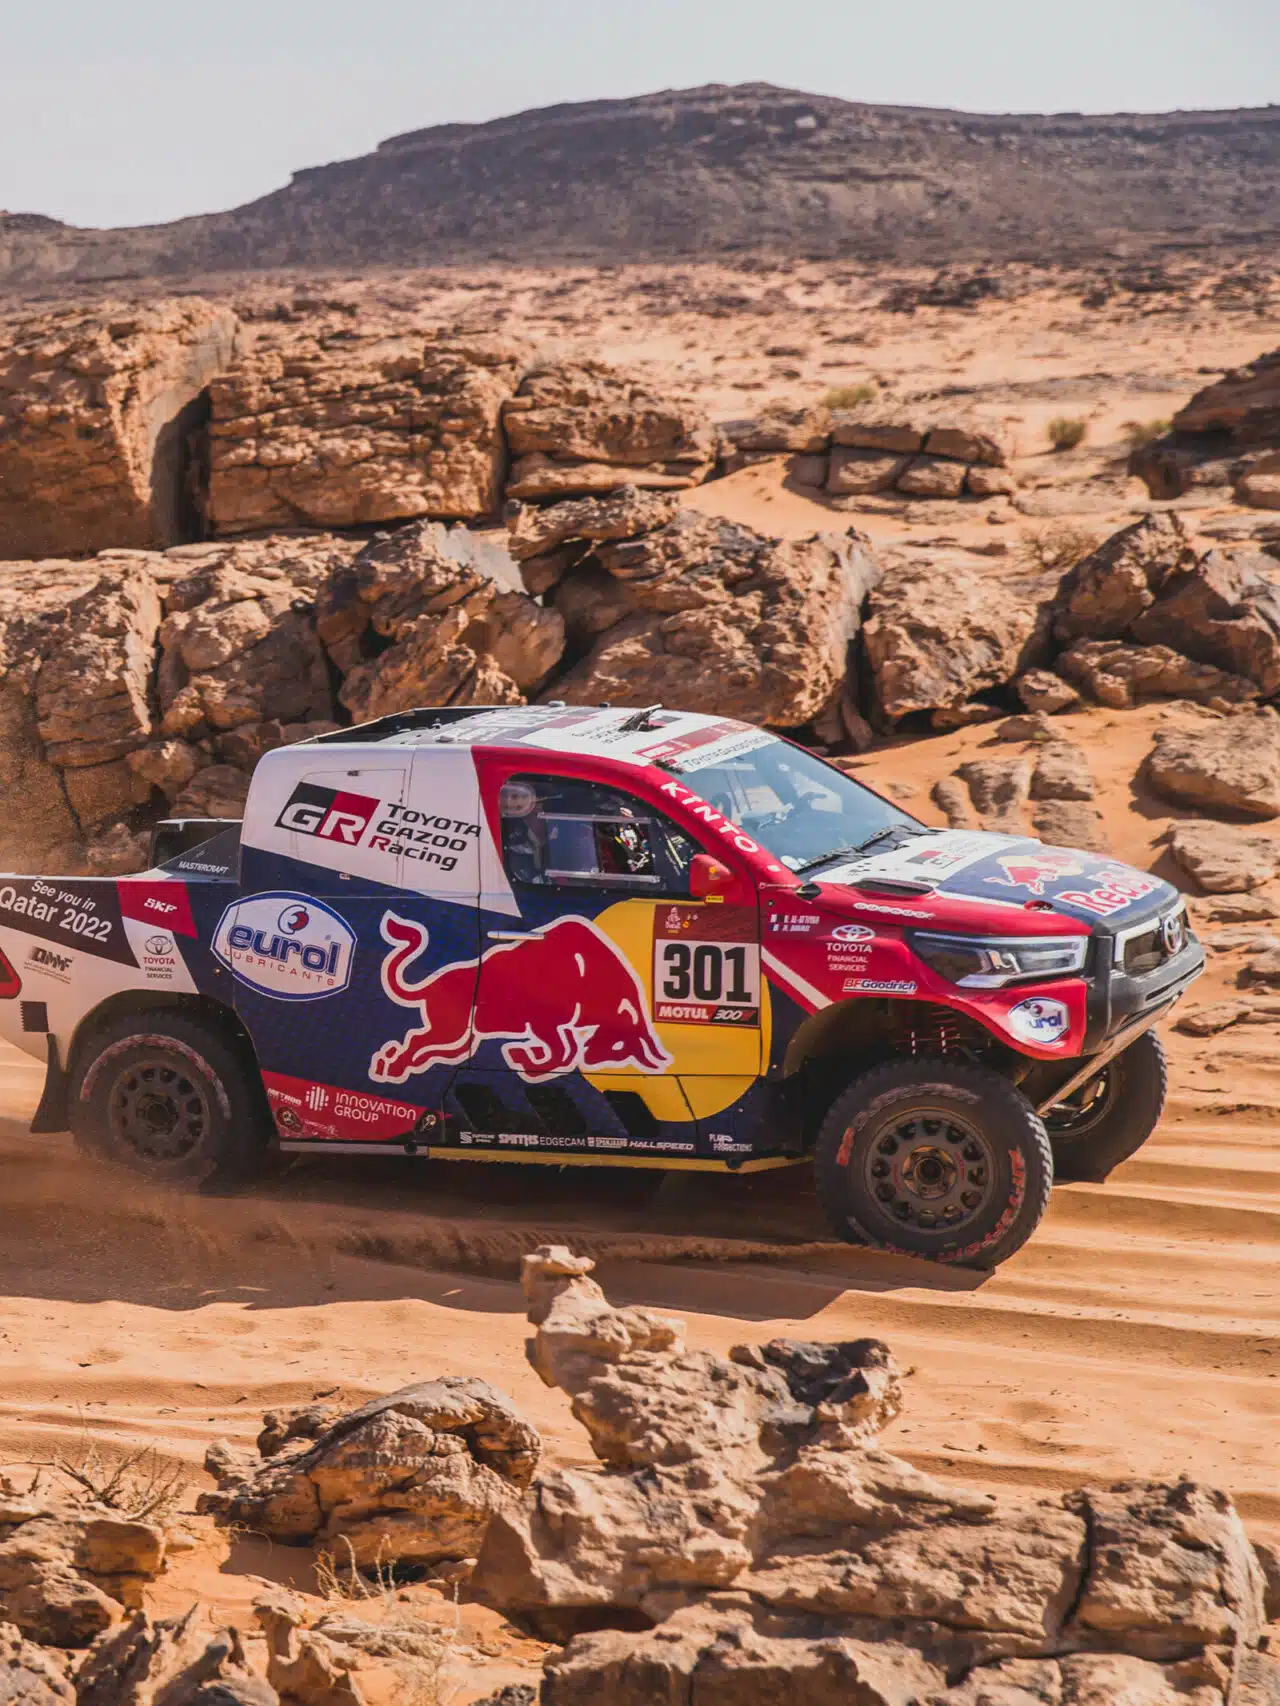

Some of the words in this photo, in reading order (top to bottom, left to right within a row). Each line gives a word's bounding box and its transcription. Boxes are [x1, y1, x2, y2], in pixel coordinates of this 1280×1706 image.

[278, 801, 367, 846] GR
[387, 803, 482, 838] TOYOTA
[660, 781, 759, 853] KINTO
[376, 820, 468, 852] GAZOO
[368, 834, 458, 872] Racing
[179, 861, 229, 873] MASTERCRAFT
[31, 879, 57, 897] See
[57, 890, 82, 908] you
[82, 896, 97, 912] in
[144, 897, 178, 914] SKF
[59, 909, 114, 943] 2022
[227, 924, 342, 977] eurol
[826, 942, 872, 953] TOYOTA
[143, 956, 176, 966] TOYOTA
[223, 947, 336, 987] LUBRICANTS
[827, 954, 869, 963] FINANCIAL
[828, 963, 867, 972] SERVICES
[663, 943, 752, 1003] 301
[843, 977, 918, 991] BFGoodrich
[658, 1004, 710, 1020] MOTUL
[333, 1104, 380, 1124] GROUP
[540, 1136, 586, 1147] EDGECAM
[629, 1140, 694, 1151] HALLSPEED
